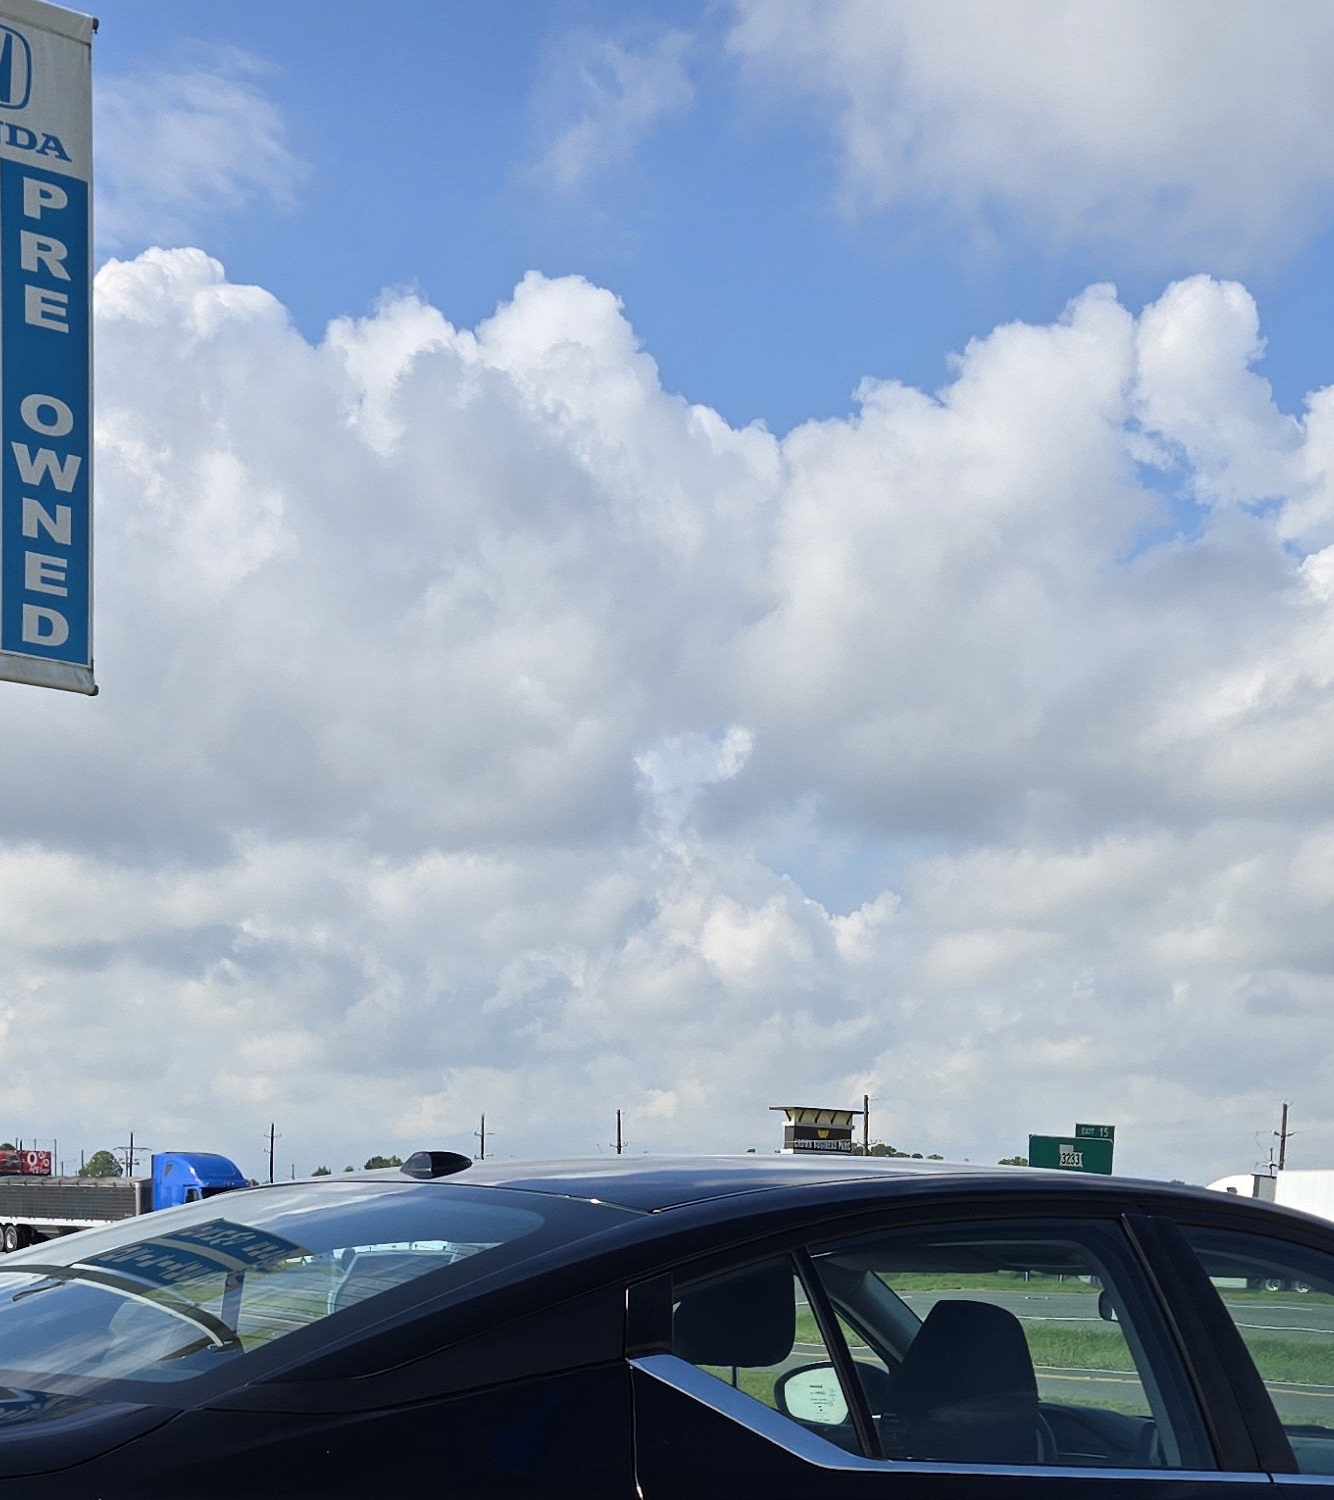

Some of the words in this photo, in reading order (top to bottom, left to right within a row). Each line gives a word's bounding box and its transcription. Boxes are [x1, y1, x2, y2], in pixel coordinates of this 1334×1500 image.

[20, 176, 72, 334] PRE
[11, 393, 82, 647] OWNED
[1099, 1127, 1109, 1138] 15
[813, 1139, 837, 1150] BUSINESS
[1061, 1152, 1080, 1165] 3233
